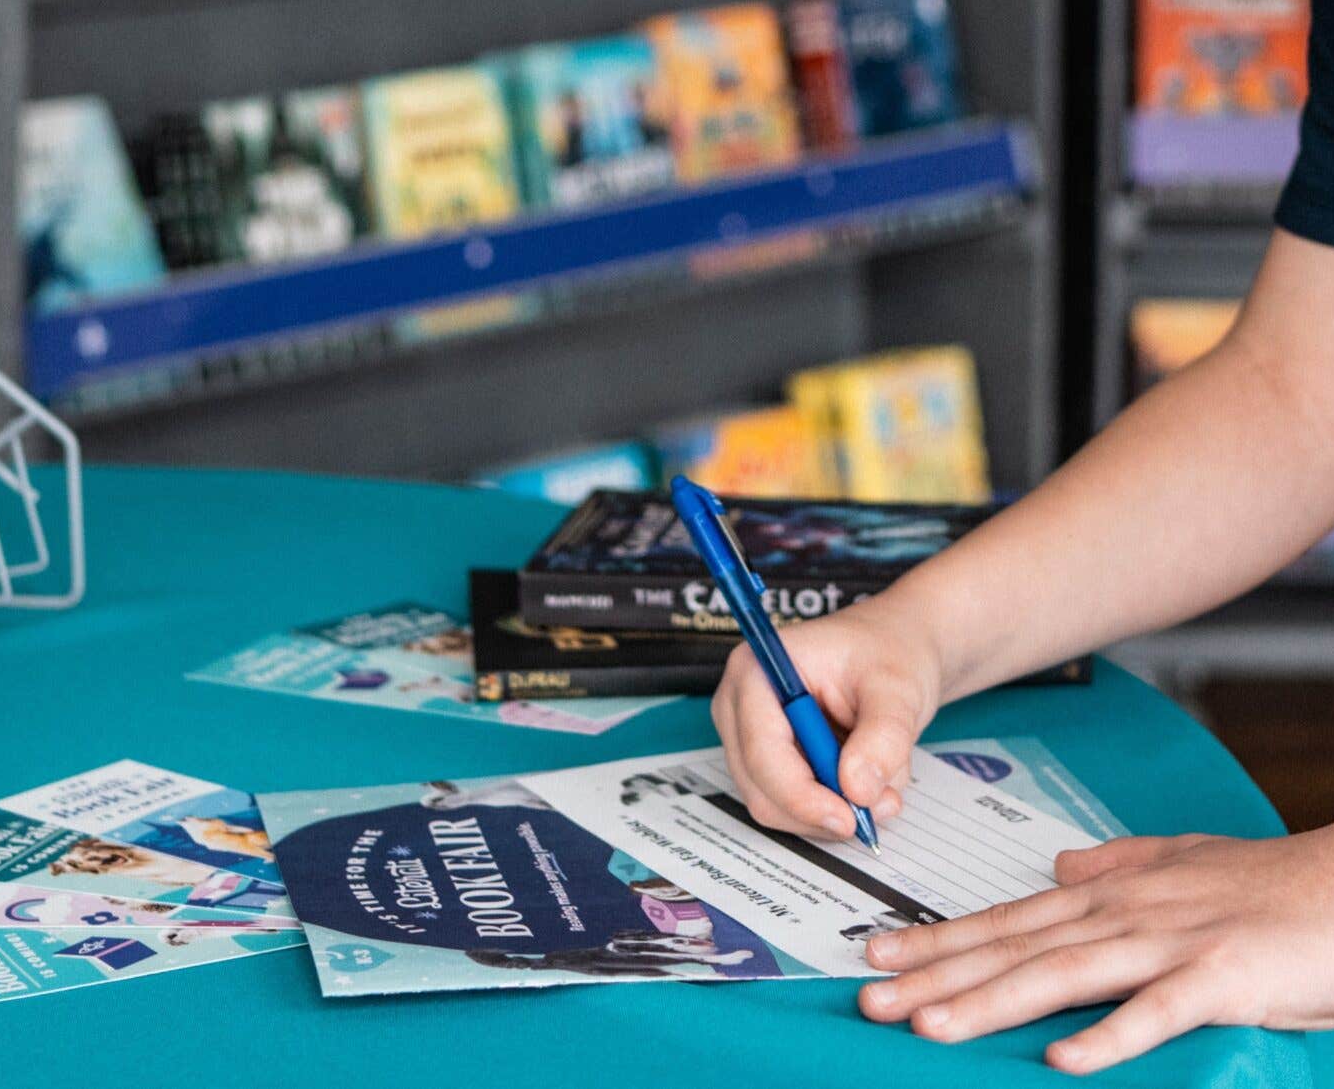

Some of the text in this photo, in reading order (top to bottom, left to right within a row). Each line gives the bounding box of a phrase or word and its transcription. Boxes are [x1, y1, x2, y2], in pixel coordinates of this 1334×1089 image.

[682, 580, 844, 616] CAELOT
[351, 829, 384, 853] THE
[345, 857, 367, 880] FOR
[428, 816, 535, 938] BOOK FAIR
[349, 882, 386, 914] TIME
